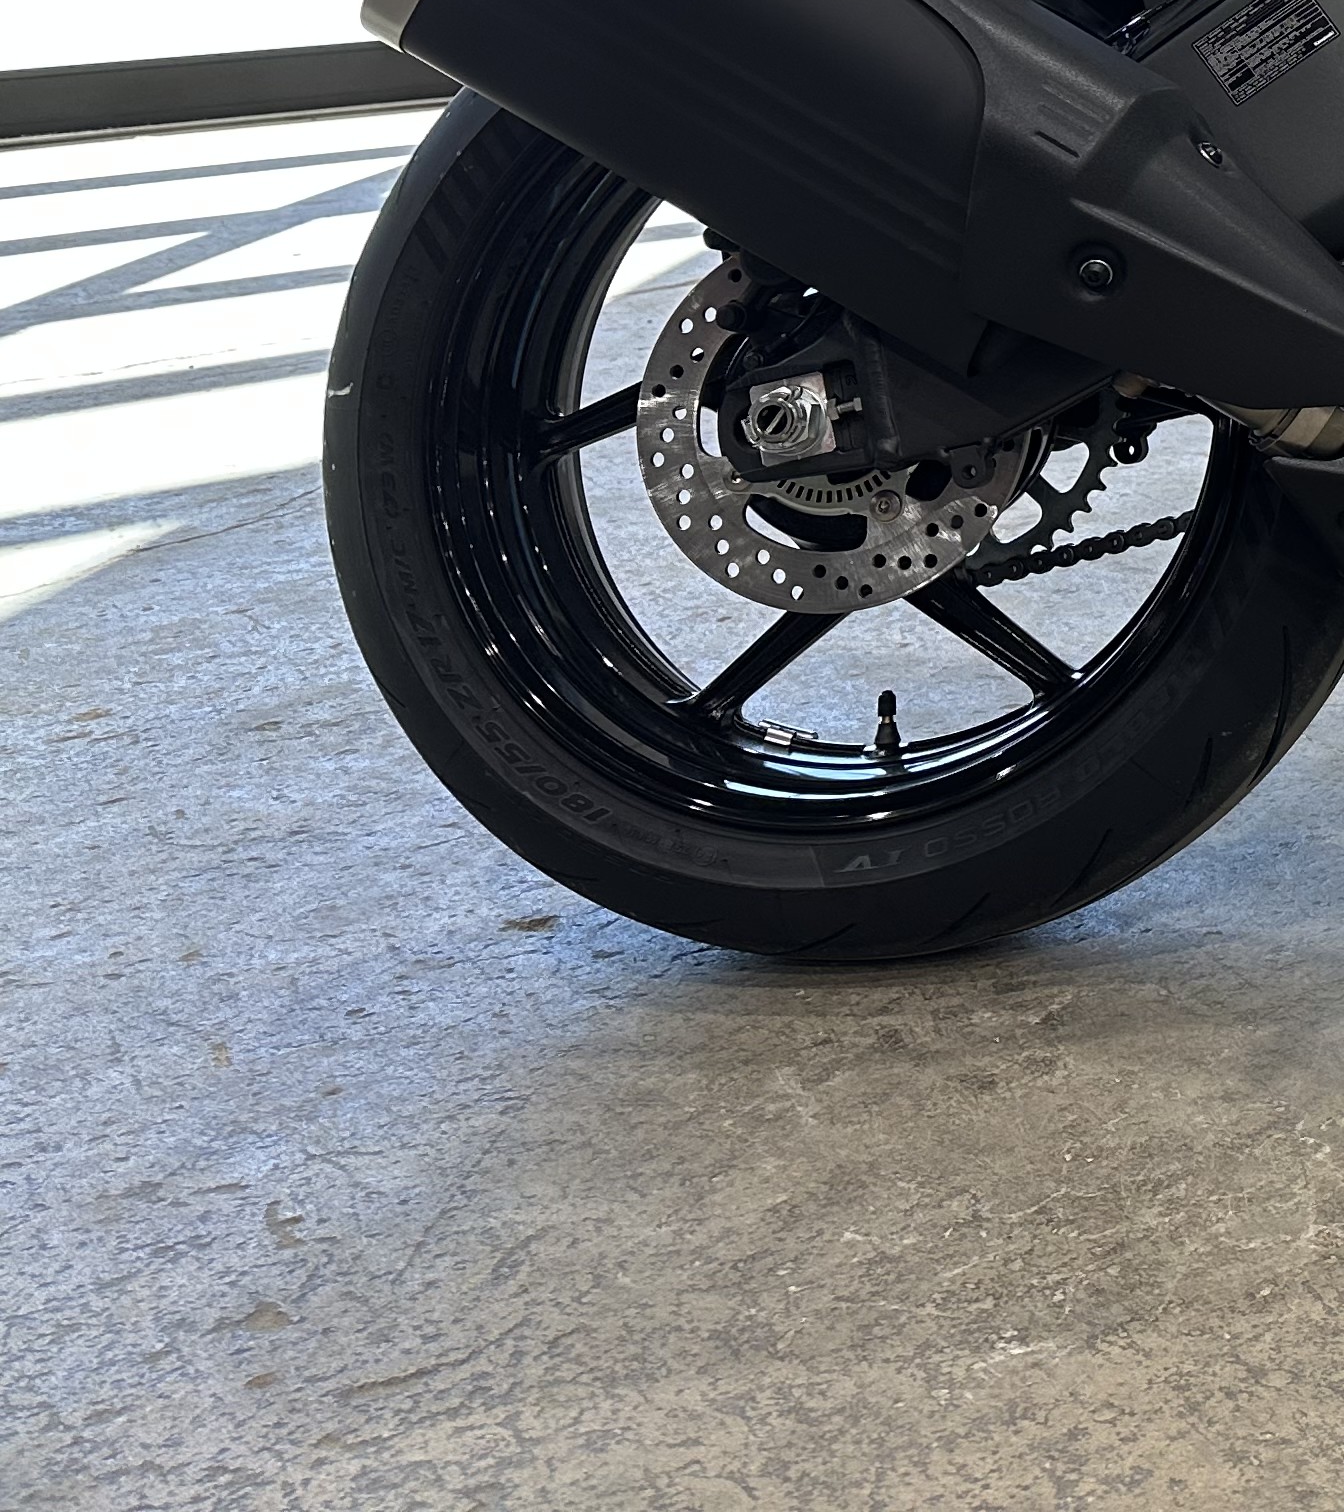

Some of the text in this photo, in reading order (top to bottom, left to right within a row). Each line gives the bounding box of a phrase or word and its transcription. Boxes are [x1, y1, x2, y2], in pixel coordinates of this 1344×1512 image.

[474, 718, 614, 827] 180/55
[923, 786, 1061, 858] ROSSO
[833, 848, 912, 873] IV
